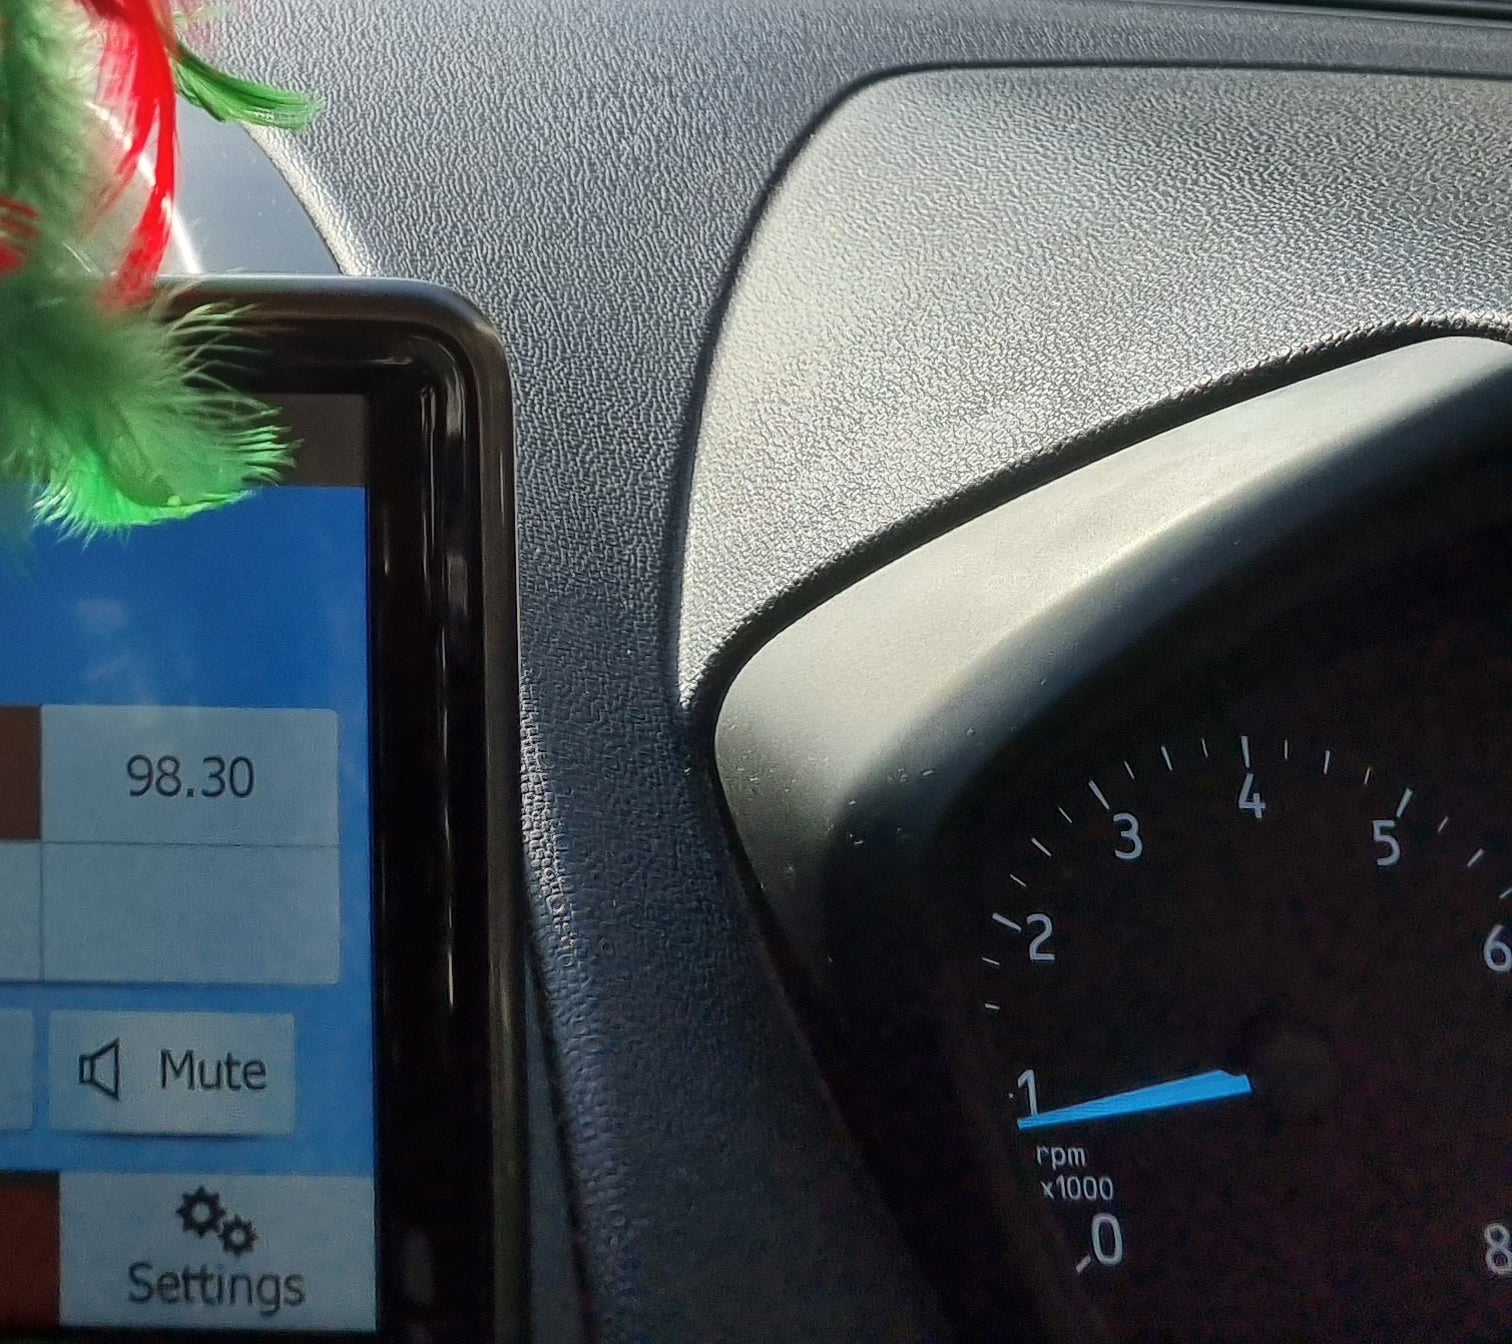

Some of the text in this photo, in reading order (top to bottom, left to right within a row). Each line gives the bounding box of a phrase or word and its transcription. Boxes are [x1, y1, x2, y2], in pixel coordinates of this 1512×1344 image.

[125, 754, 255, 799] 98.30
[1237, 773, 1267, 819] 4
[1112, 812, 1144, 860] 3
[1371, 819, 1402, 867] 5
[1025, 913, 1055, 961] 2
[1482, 924, 1512, 973] 6
[160, 1048, 268, 1091] Mute
[1016, 1068, 1039, 1118] 1
[1035, 1145, 1087, 1171] rpm
[1039, 1174, 1115, 1202] x1000
[1090, 1211, 1124, 1268] 0
[1482, 1222, 1512, 1275] 8
[127, 1260, 306, 1317] Settings
